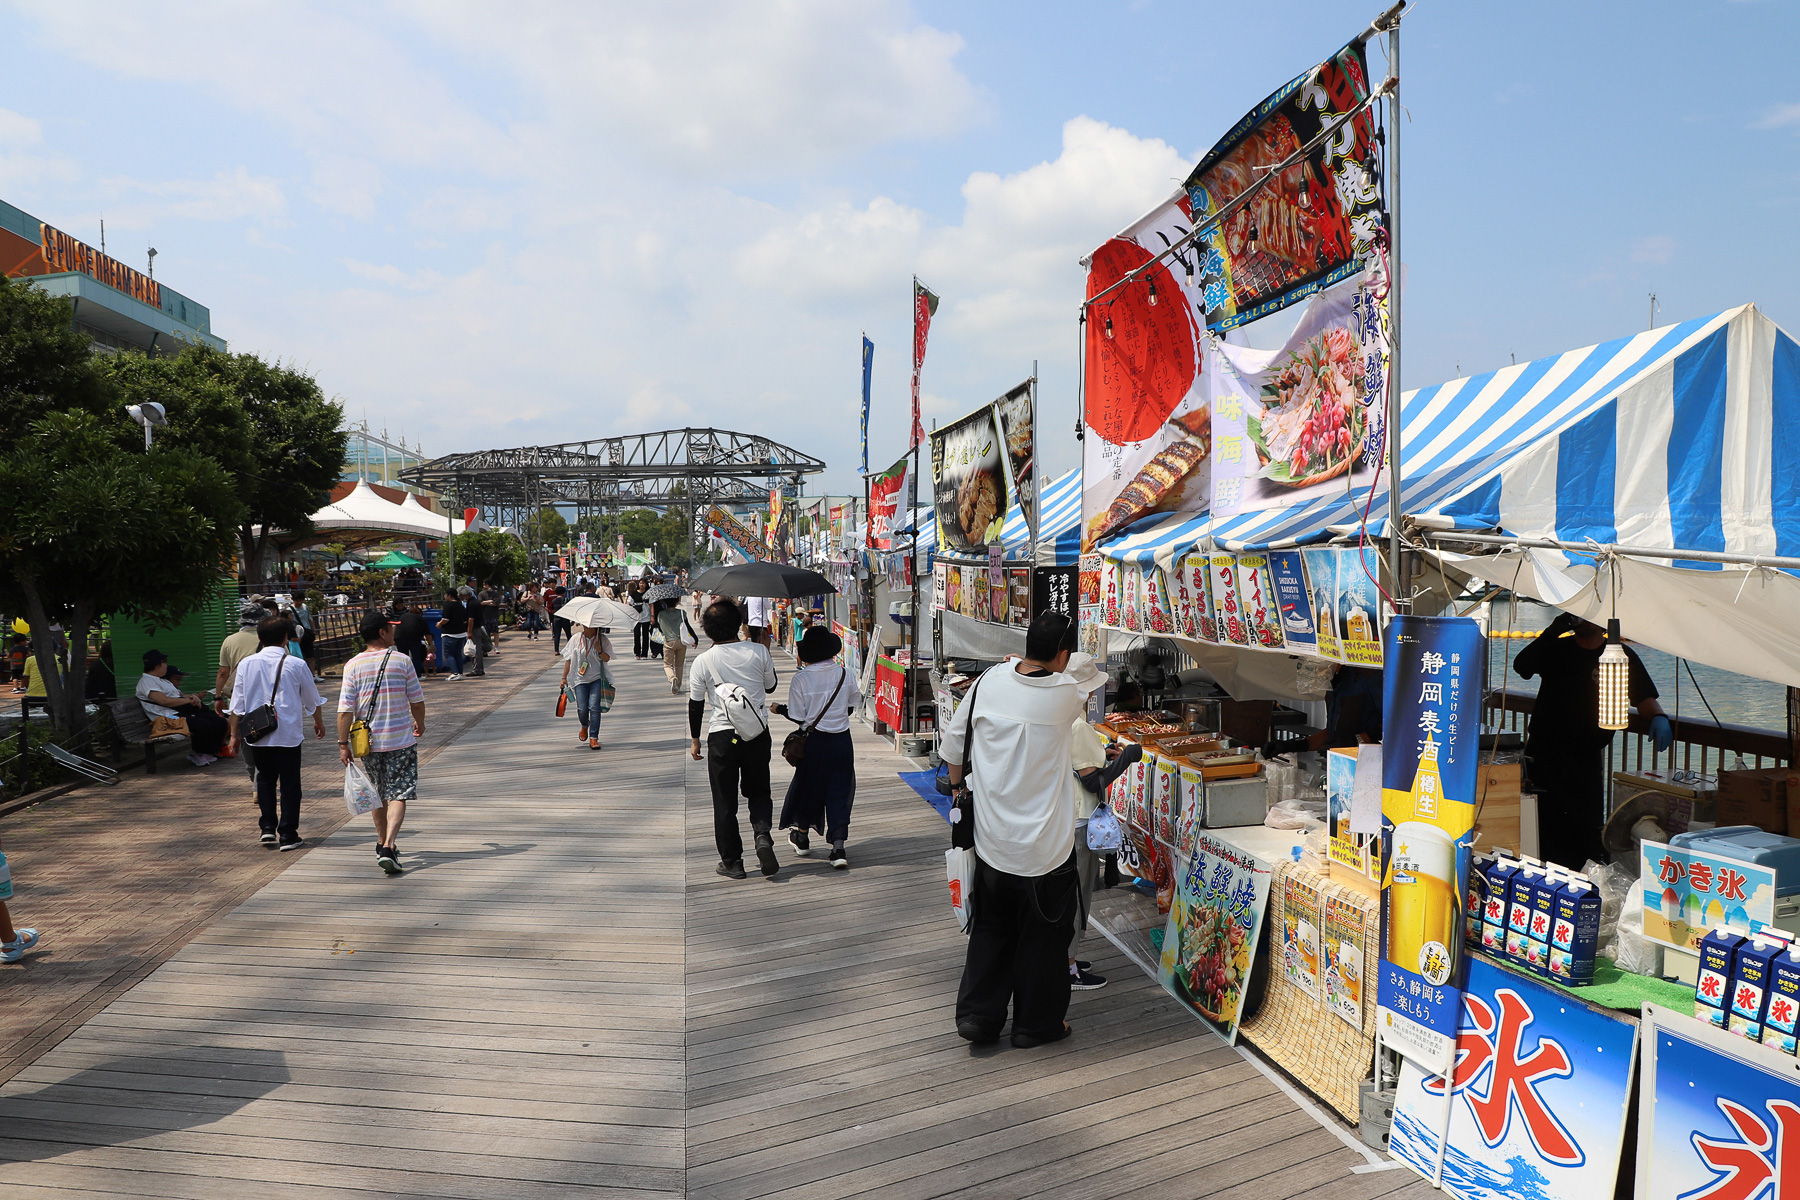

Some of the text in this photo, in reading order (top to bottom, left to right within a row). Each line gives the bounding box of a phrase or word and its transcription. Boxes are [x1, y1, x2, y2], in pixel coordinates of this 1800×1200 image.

[1221, 295, 1286, 328] Grilled
[1290, 283, 1318, 301] squid
[1220, 567, 1241, 641] つぶ貝
[1249, 568, 1271, 644] イイダコ
[1416, 651, 1447, 762] 静岡麦酒
[1447, 652, 1460, 764] 静岡県だけの生ビール
[1160, 773, 1171, 840] つぶ貝
[1418, 774, 1436, 814] 樽生
[1186, 851, 1256, 929] 海鮮焼
[1659, 855, 1747, 901] かき氷
[1487, 901, 1501, 919] 氷
[1512, 908, 1526, 926] 氷
[1533, 915, 1546, 934] 氷
[1662, 920, 1678, 930] いちご
[1556, 924, 1569, 943] 氷
[1684, 927, 1699, 936] メロン
[1690, 938, 1701, 950] ¥5
[1390, 972, 1444, 1005] さあ、静岡を
[1701, 976, 1720, 998] 氷
[1736, 986, 1756, 1010] 氷
[1394, 992, 1435, 1025] 楽しもう。
[1771, 1000, 1791, 1024] 氷
[1422, 988, 1585, 1168] 氷
